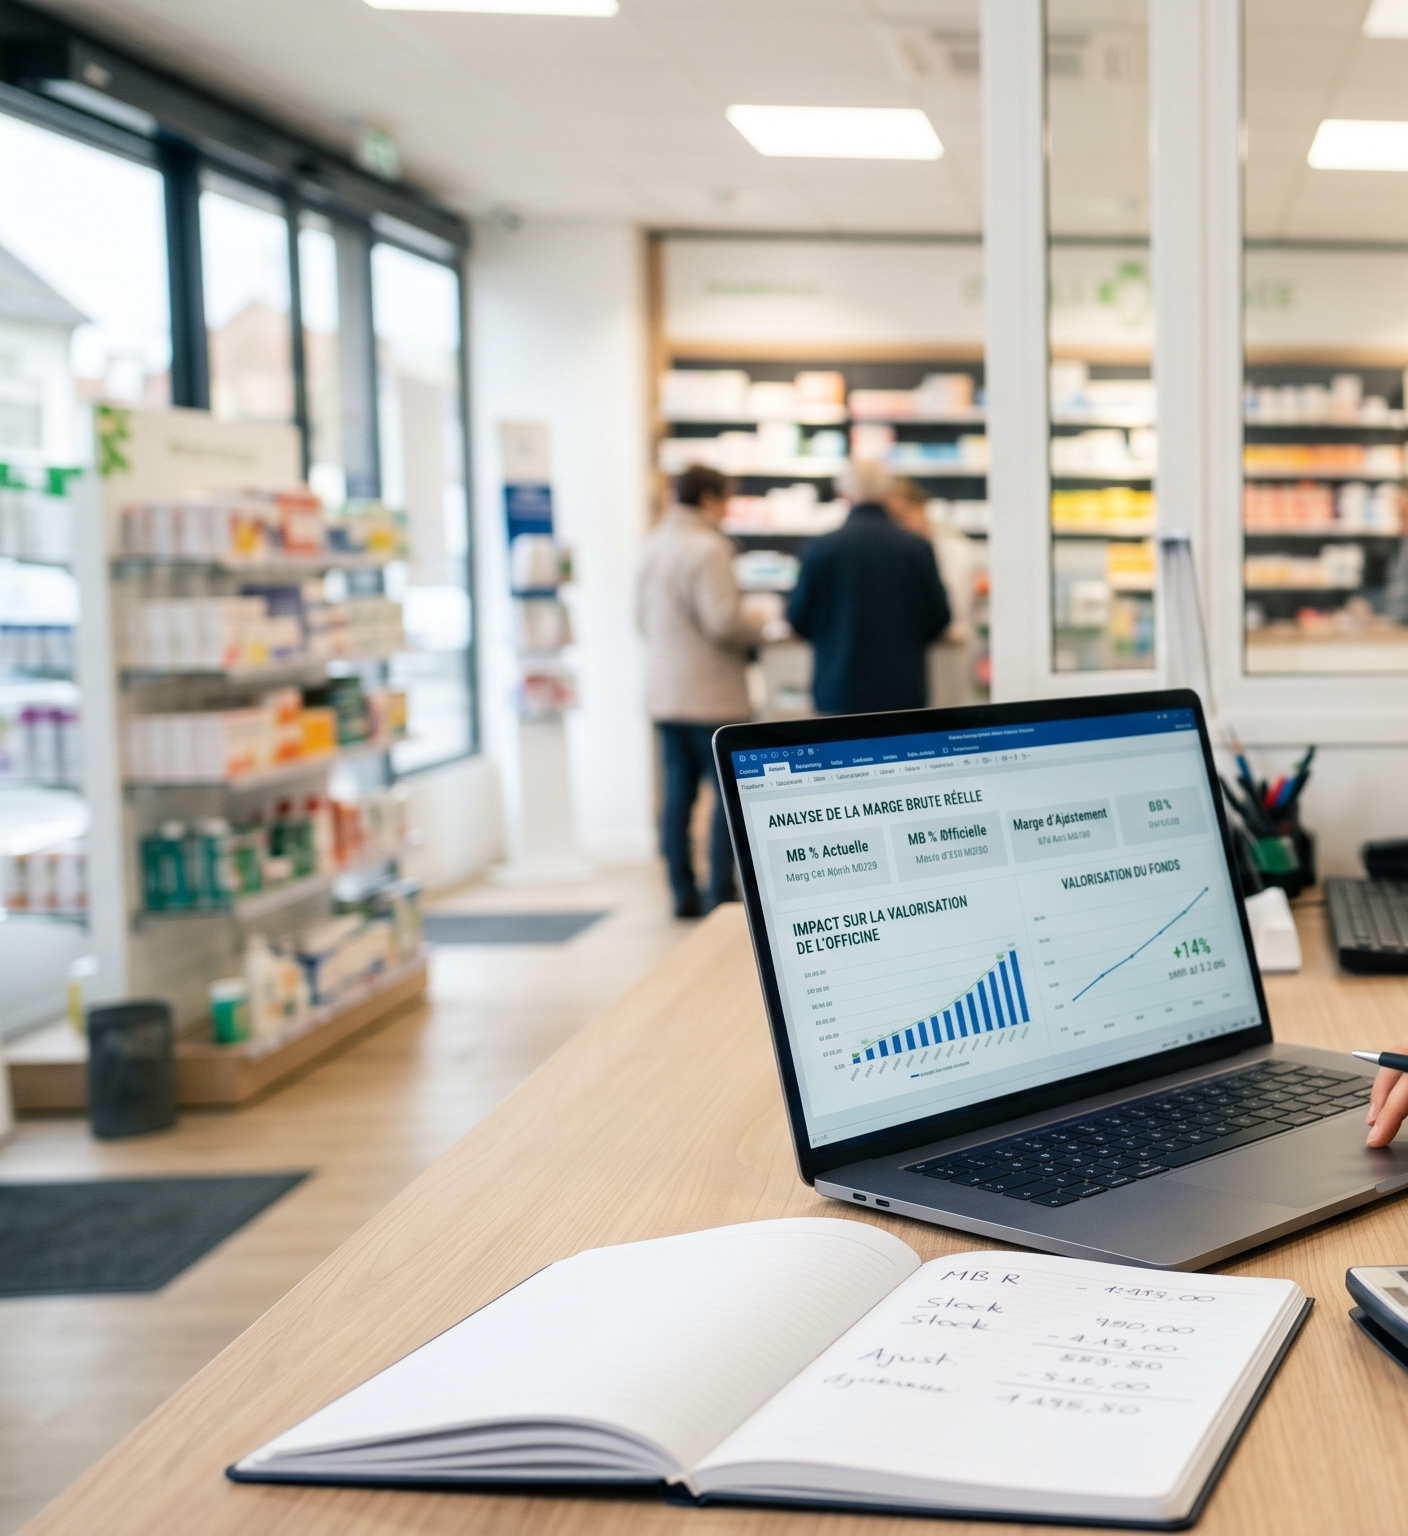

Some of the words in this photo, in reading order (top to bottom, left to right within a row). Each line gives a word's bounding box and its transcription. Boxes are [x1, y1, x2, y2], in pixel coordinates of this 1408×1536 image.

[769, 809, 824, 828] ANALYSE
[826, 807, 842, 820] DE
[845, 804, 860, 818] LA
[862, 800, 904, 817] MARGE
[906, 794, 942, 811] BRUTE
[944, 789, 983, 807] RÉELLE
[1013, 818, 1044, 831] Marge
[908, 831, 926, 846] MB
[928, 830, 938, 843] %
[786, 848, 807, 863] MB
[809, 846, 819, 859] %
[822, 840, 869, 858] Actuelle
[1061, 868, 1132, 890] VALORISATION
[1133, 865, 1147, 878] DU
[1148, 859, 1181, 875] FONDS
[792, 916, 840, 937] IMPACT
[843, 911, 868, 928] SUR
[869, 908, 886, 923] LA
[887, 895, 968, 920] VALORISATION
[796, 940, 814, 955] DE
[816, 928, 880, 952] L'OFFICINE
[1173, 937, 1211, 958] +14%
[917, 1297, 1004, 1314] Stock
[901, 1314, 993, 1332] Stock
